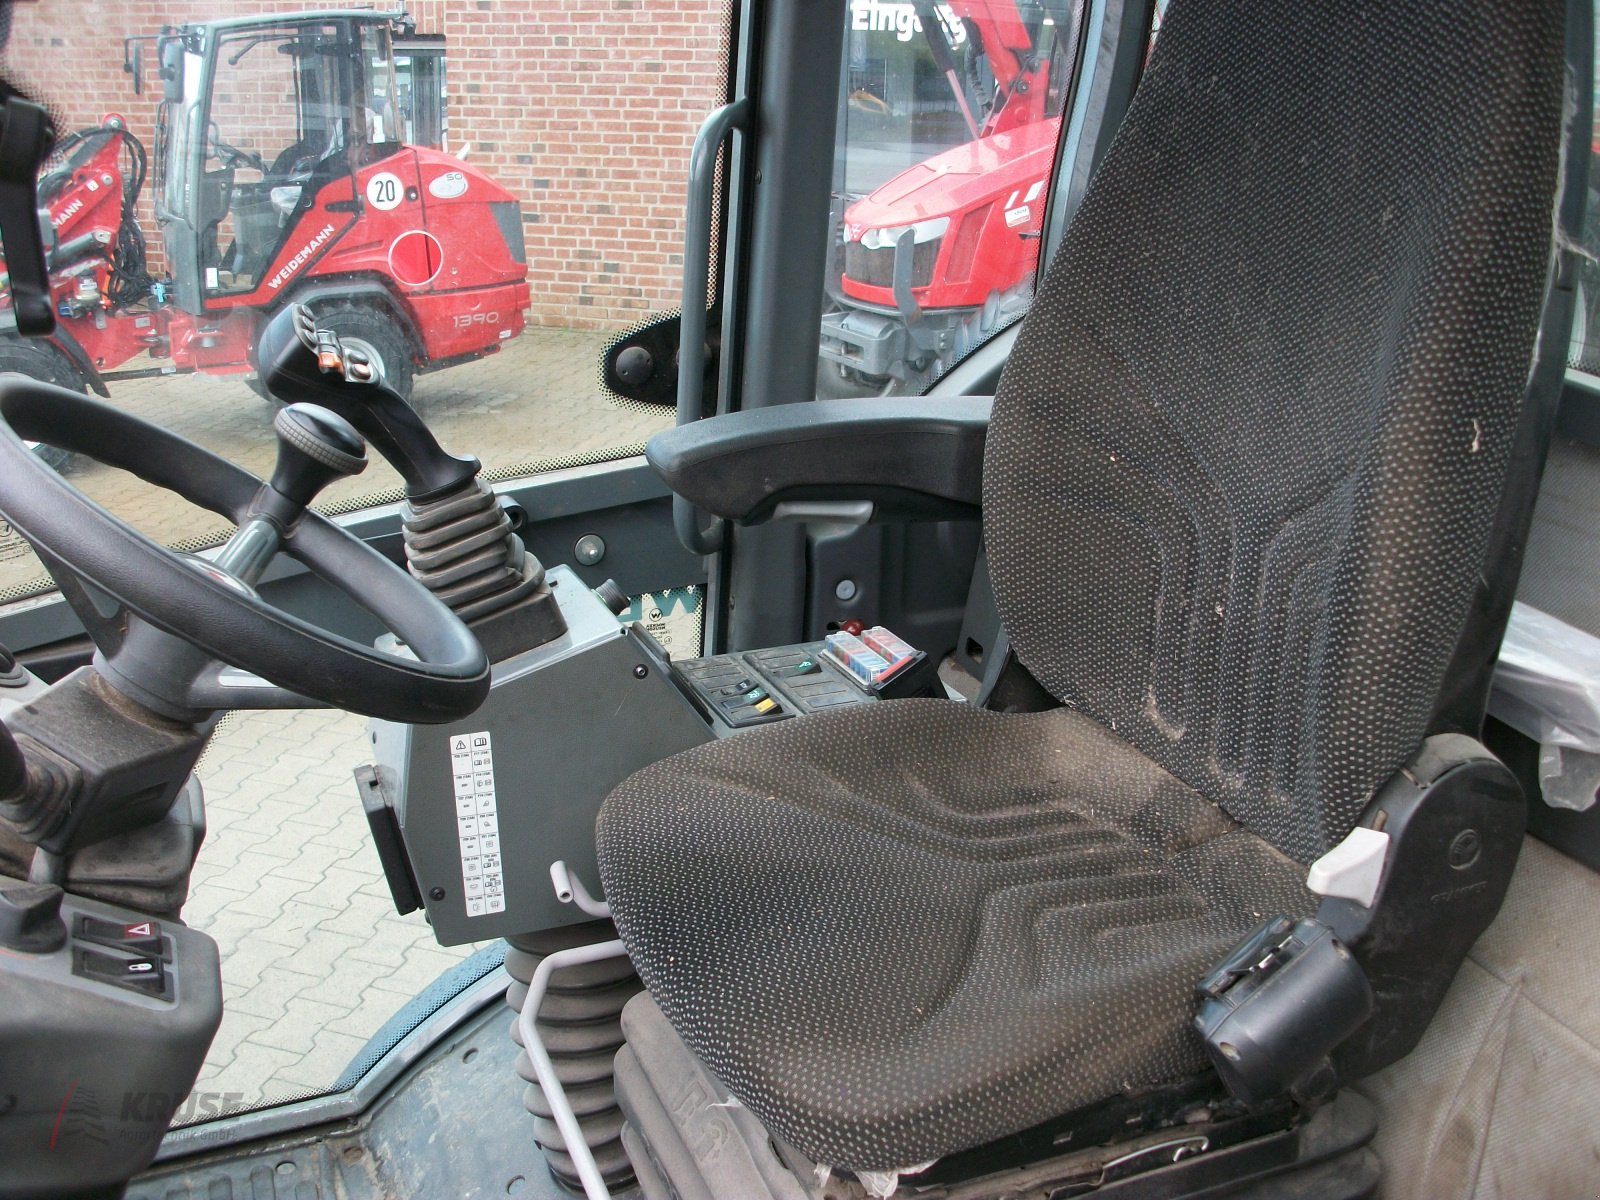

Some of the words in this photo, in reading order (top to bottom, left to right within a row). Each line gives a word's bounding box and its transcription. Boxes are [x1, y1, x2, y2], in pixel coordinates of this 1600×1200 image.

[375, 180, 396, 203] 20
[267, 223, 335, 289] WEIDEMANN
[453, 311, 499, 328] 1390
